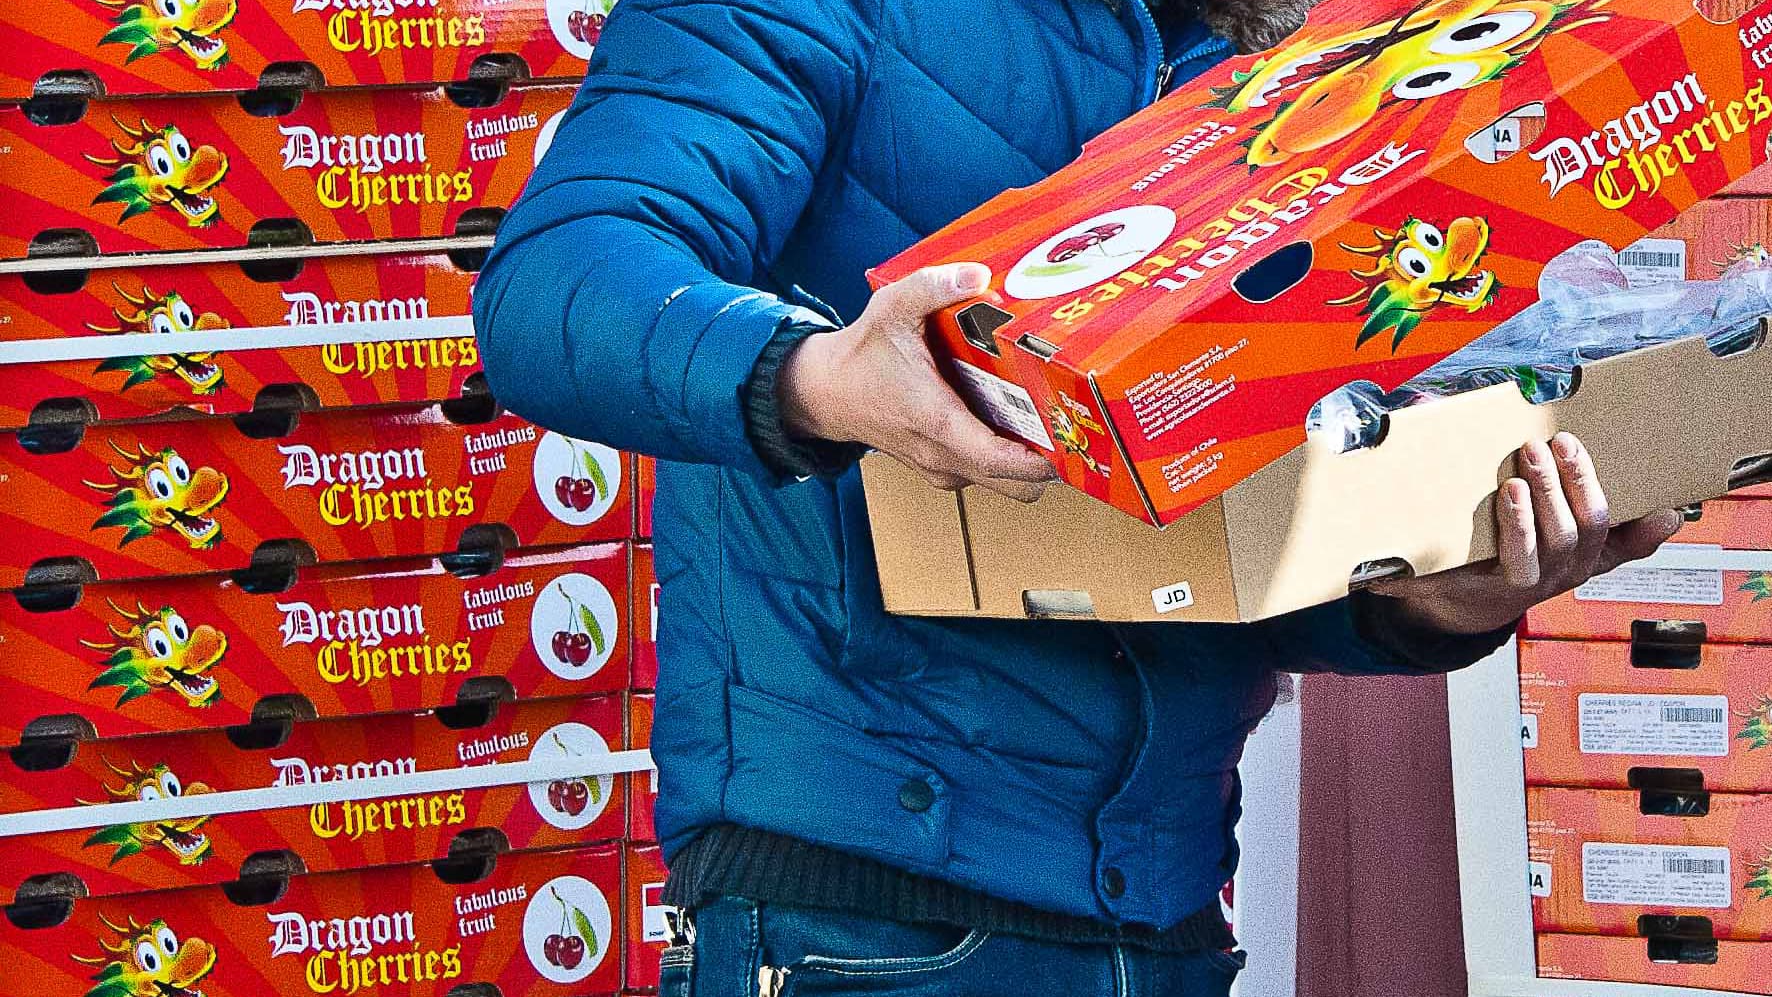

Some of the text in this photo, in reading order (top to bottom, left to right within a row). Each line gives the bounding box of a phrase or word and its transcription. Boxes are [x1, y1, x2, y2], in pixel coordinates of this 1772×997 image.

[328, 9, 486, 55] Cherries
[279, 125, 426, 172] Dragon
[466, 114, 539, 141] fabulous
[470, 137, 506, 161] fruit
[1529, 73, 1706, 197] Dragon
[1594, 78, 1772, 209] Cherries
[317, 166, 472, 212] Cherries
[1152, 141, 1426, 292] Dragon
[1050, 167, 1328, 324] Cherries
[1125, 373, 1154, 396] Exported
[465, 426, 536, 456] fabulous
[278, 445, 427, 490] Dragon
[469, 454, 506, 475] fruit
[320, 481, 473, 528] Cherries
[464, 581, 534, 610] fabulous
[1164, 587, 1188, 605] JD
[276, 602, 424, 647] Dragon
[467, 608, 504, 630] fruit
[318, 640, 471, 685] Cherries
[309, 790, 466, 839] Cherries
[455, 885, 527, 914] fabulous
[268, 912, 415, 957] Dragon
[458, 912, 495, 936] fruit
[306, 945, 460, 994] Cherries
